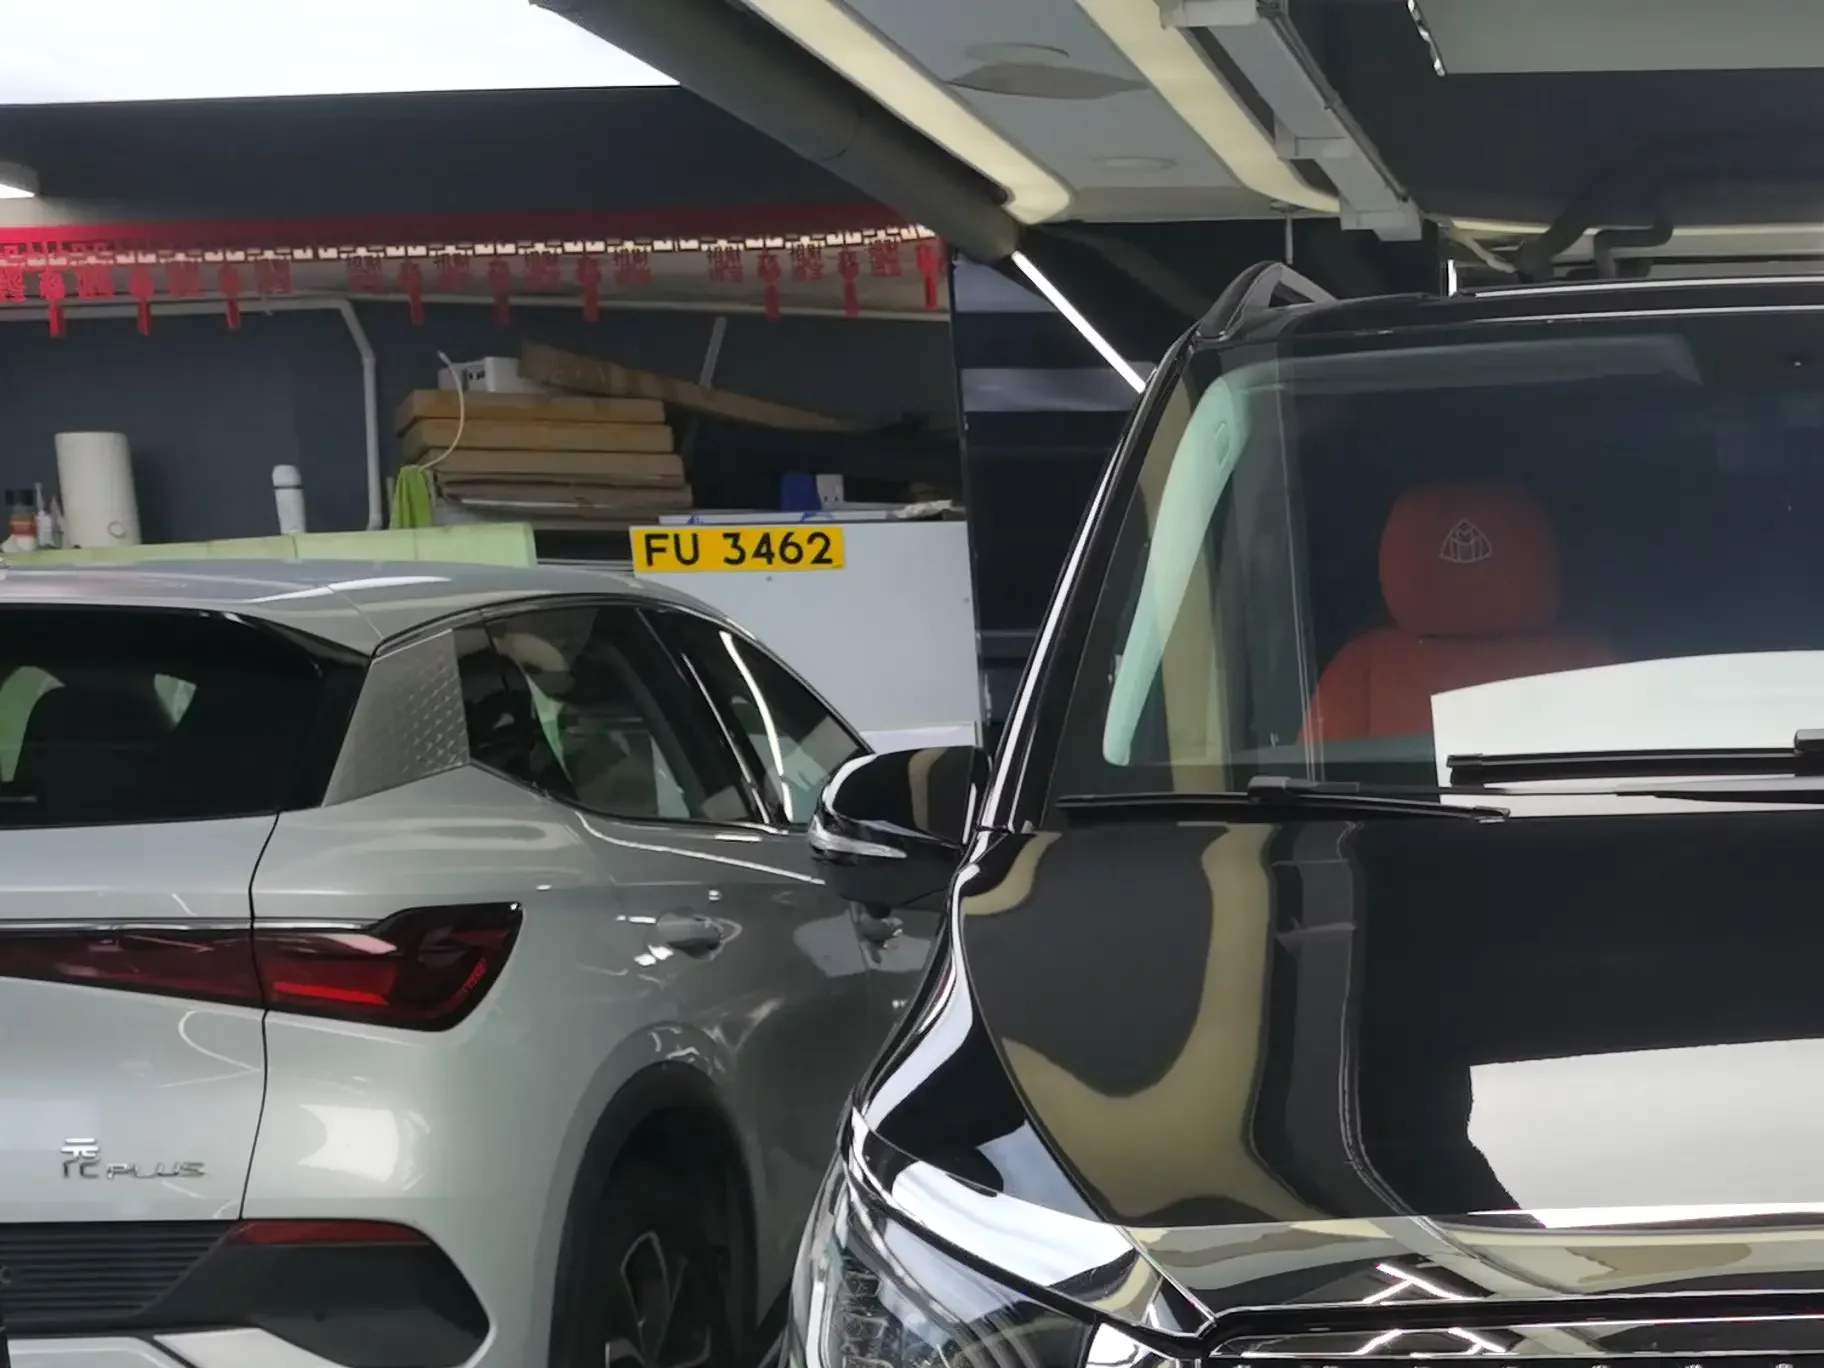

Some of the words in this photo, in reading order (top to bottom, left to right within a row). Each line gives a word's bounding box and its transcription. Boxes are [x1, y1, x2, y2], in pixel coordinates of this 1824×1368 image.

[643, 533, 699, 567] FU
[722, 531, 833, 566] 3462
[60, 1137, 100, 1180] 元
[106, 1161, 206, 1180] PLUS
